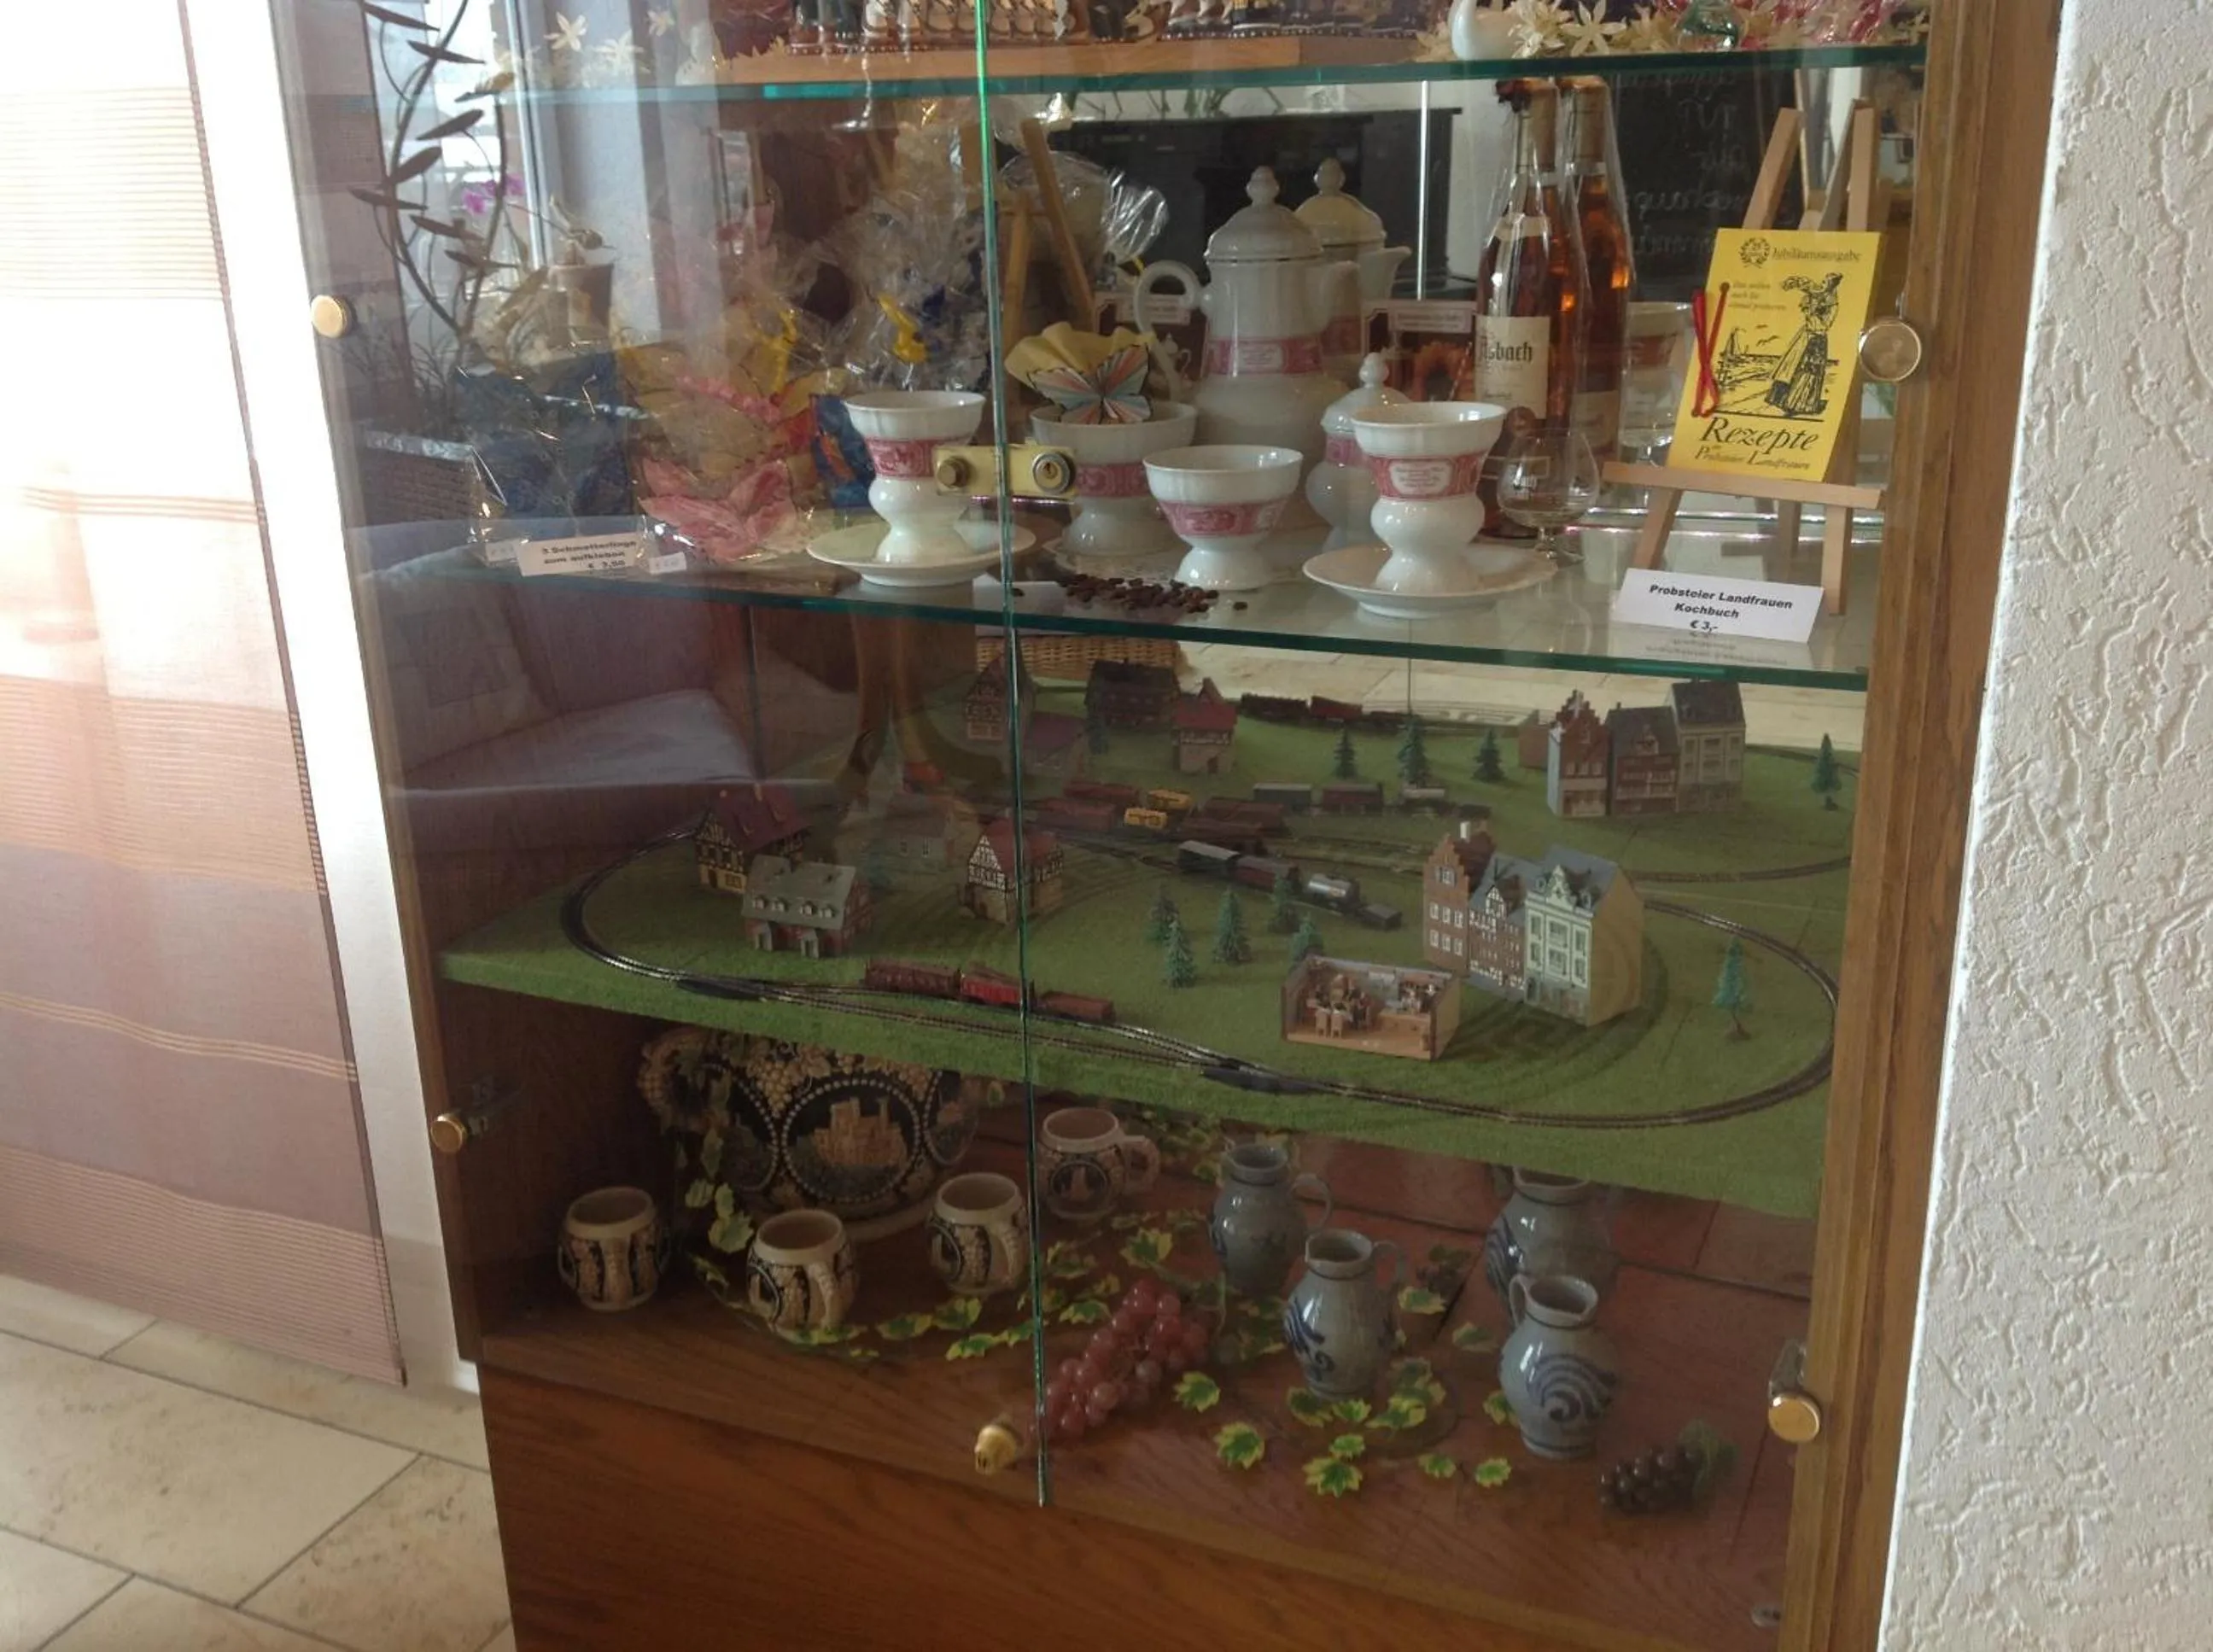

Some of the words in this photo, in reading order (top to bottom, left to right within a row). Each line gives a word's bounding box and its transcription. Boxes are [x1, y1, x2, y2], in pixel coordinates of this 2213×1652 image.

[1699, 417, 1819, 454] Rezepte
[1649, 584, 1715, 600] Probsteier
[1718, 592, 1793, 610] Landfrauen
[1674, 602, 1739, 619] Kochbuch
